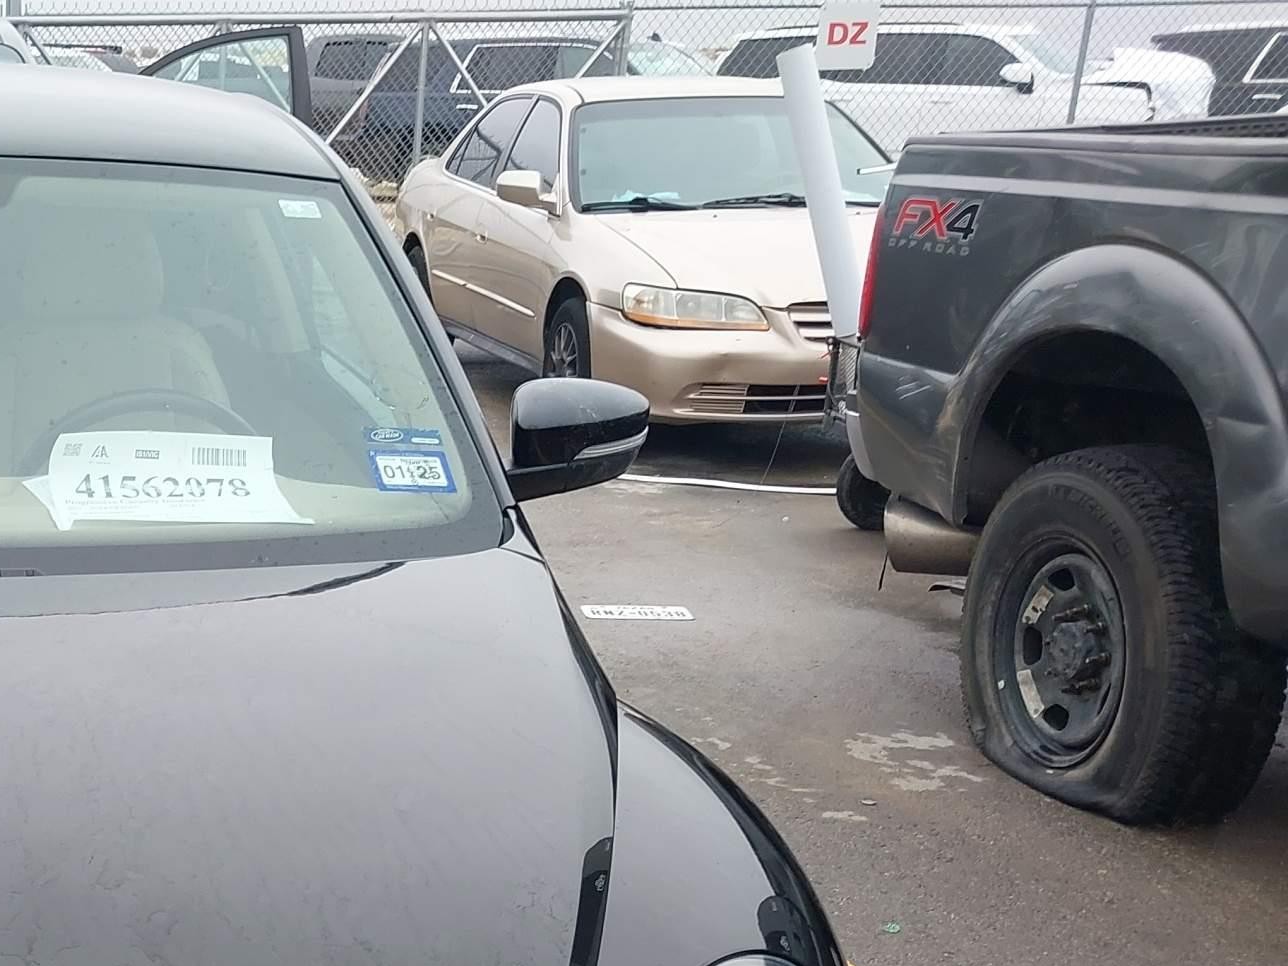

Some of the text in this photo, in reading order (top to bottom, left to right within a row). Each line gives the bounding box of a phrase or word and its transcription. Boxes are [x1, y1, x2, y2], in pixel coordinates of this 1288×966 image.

[826, 21, 870, 46] DZ
[893, 198, 984, 242] FX4
[888, 238, 970, 256] OFF ROAD
[74, 472, 252, 499] 41562078
